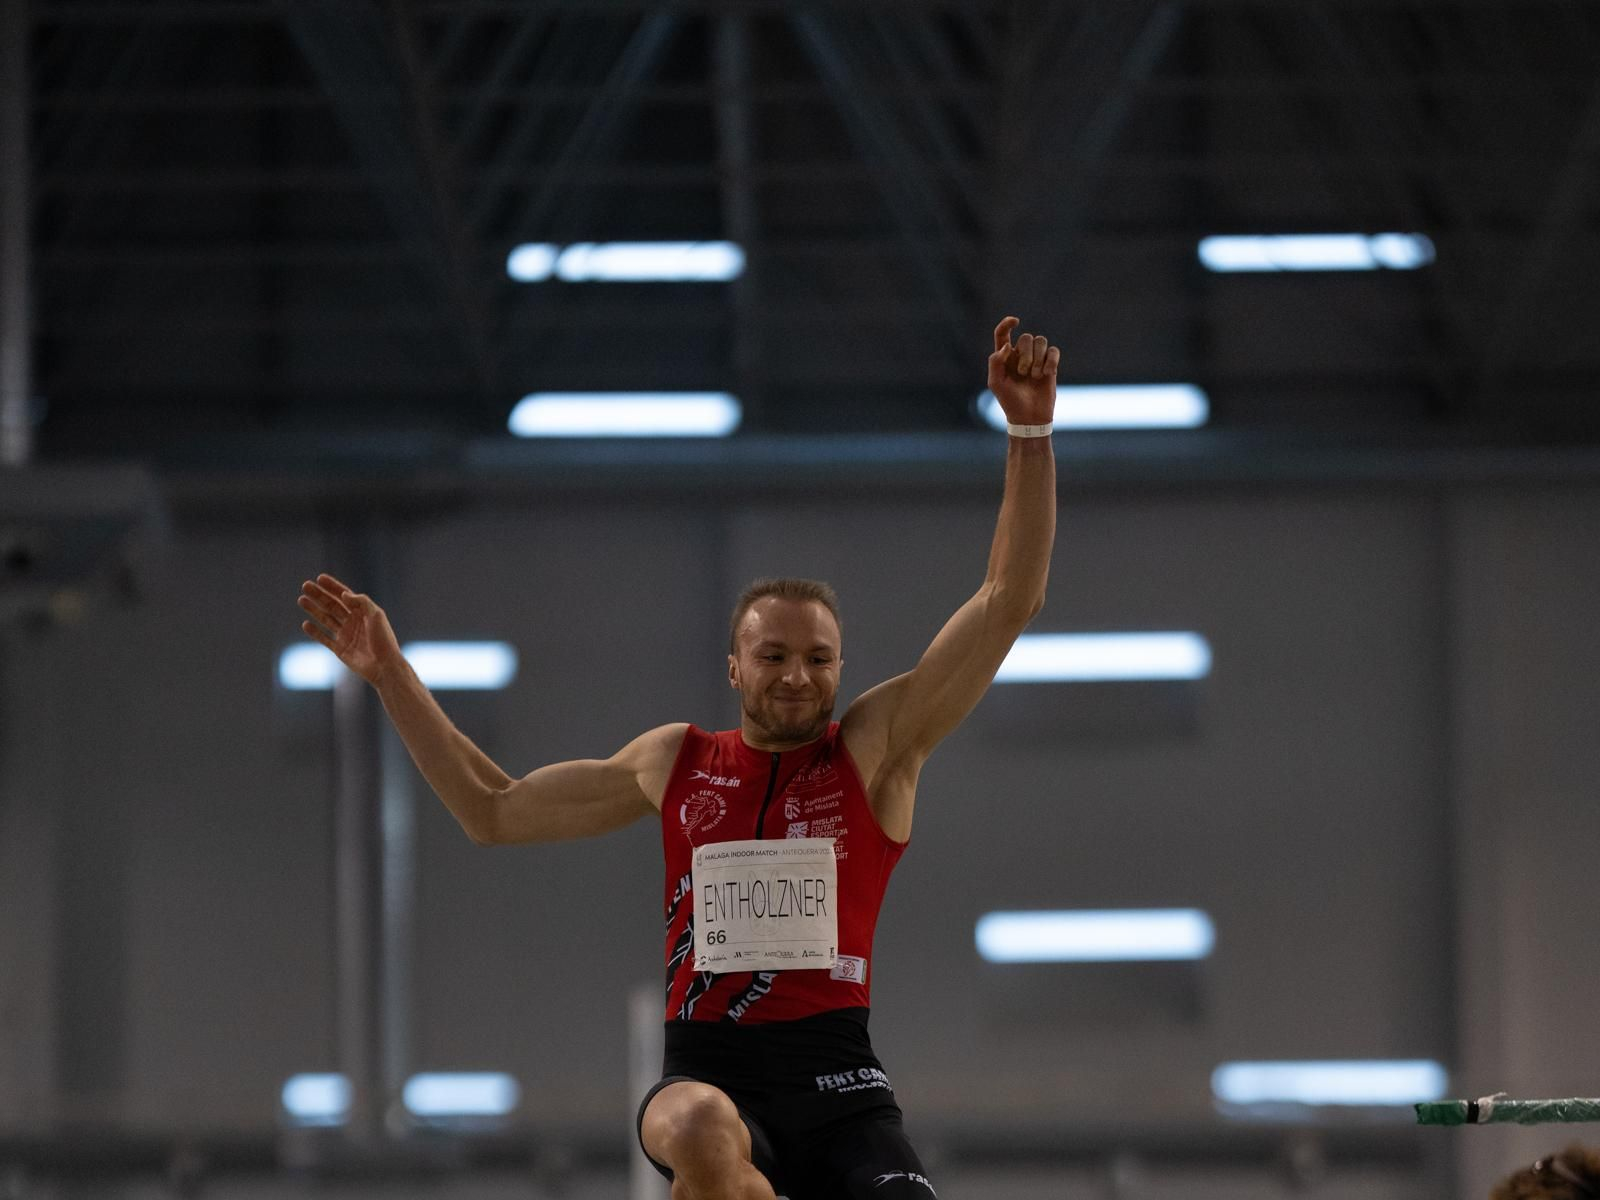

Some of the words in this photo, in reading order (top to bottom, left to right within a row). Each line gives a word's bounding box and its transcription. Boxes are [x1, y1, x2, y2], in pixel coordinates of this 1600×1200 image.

[804, 789, 844, 807] Ajuntament
[814, 800, 840, 812] Mislata
[811, 815, 843, 826] MISLATA
[811, 823, 835, 833] CIUTAT
[730, 848, 755, 858] INDOOR
[755, 849, 778, 857] MATCH
[704, 879, 827, 923] ENTHOLZNER
[706, 929, 727, 945] 66
[815, 1069, 856, 1092] FENT
